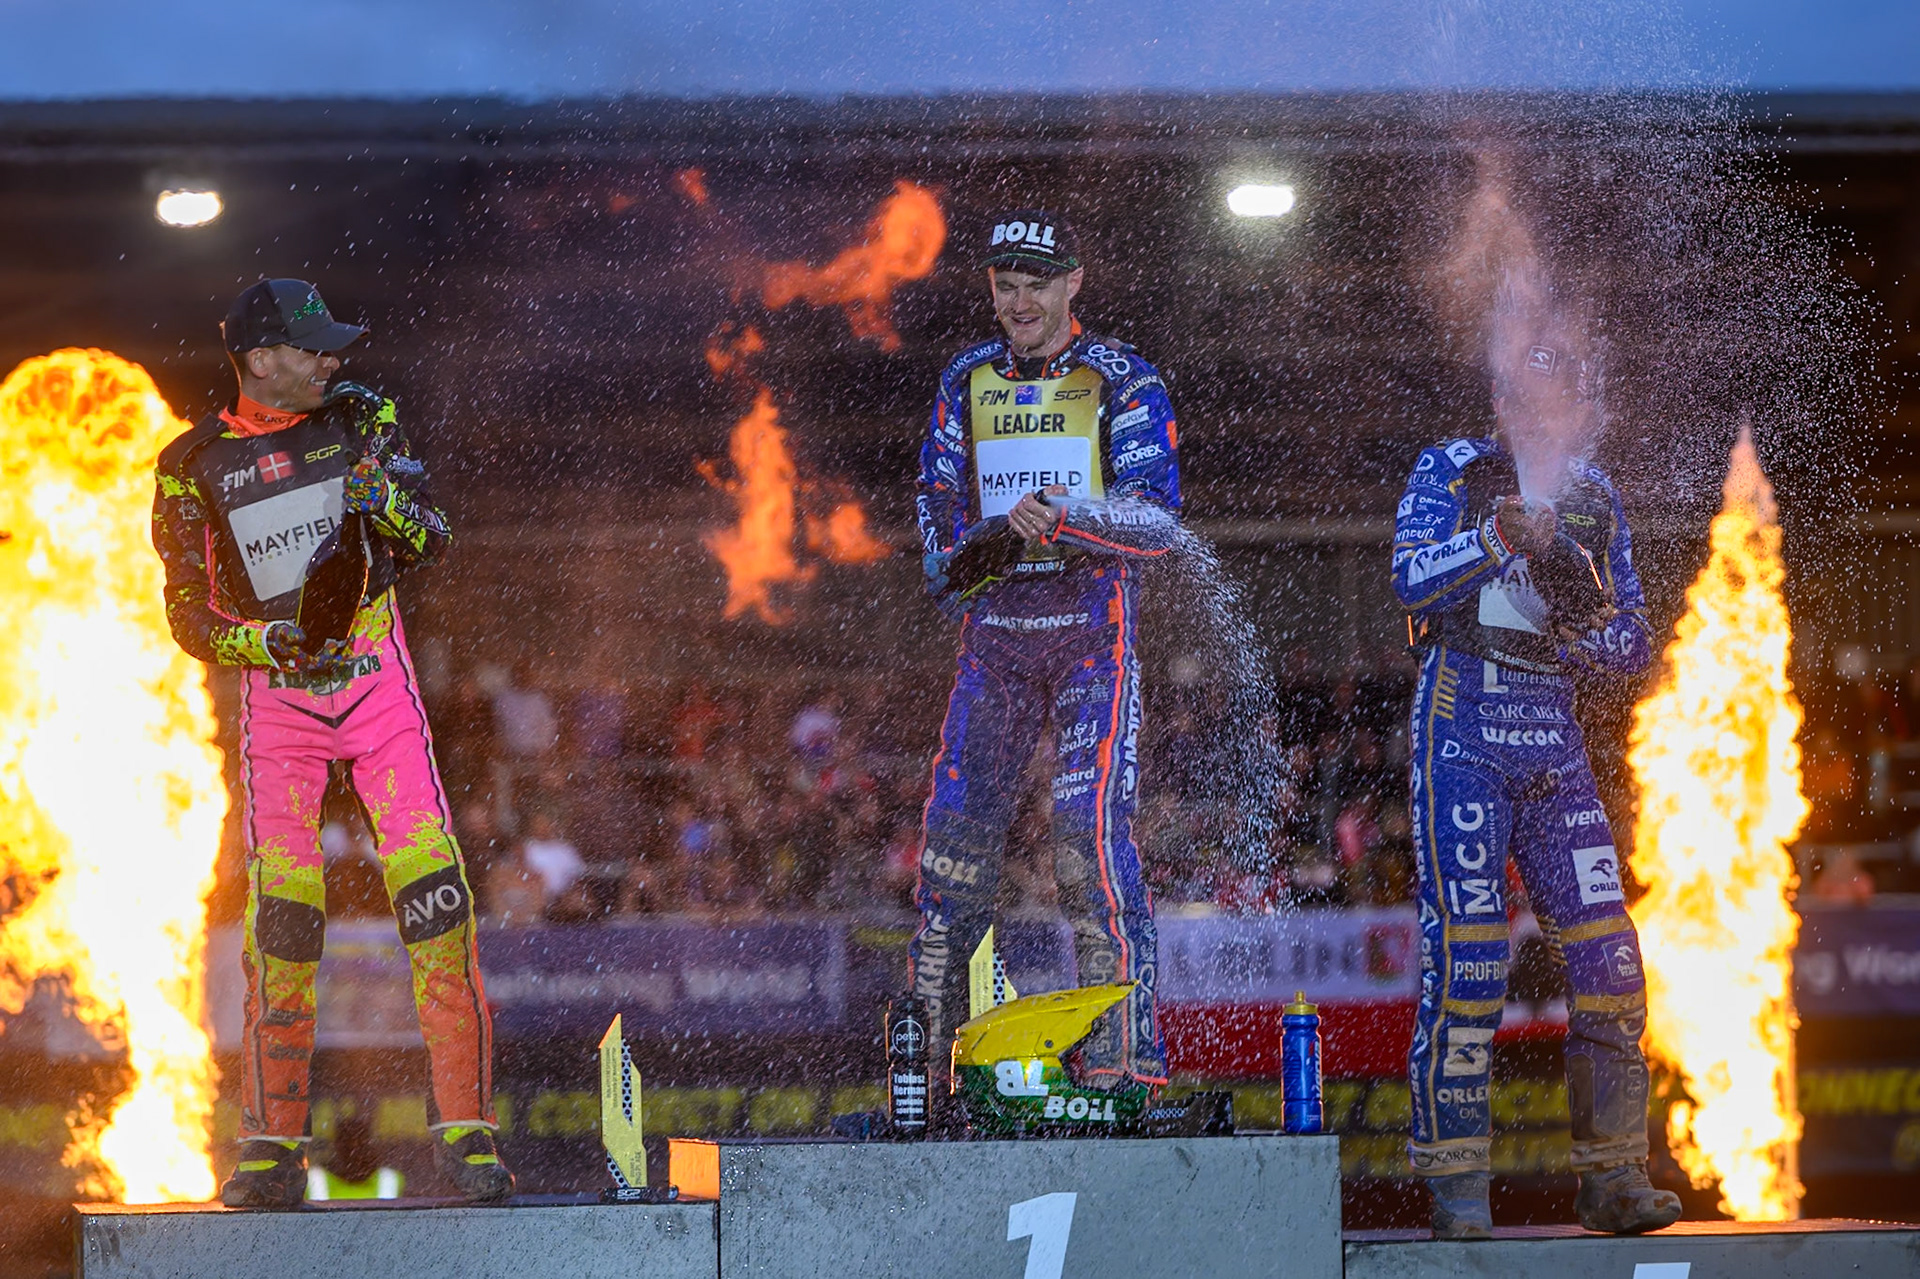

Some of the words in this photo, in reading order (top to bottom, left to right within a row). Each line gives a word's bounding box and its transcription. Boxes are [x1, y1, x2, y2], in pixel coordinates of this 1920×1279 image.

[991, 221, 1056, 246] BOLL
[977, 389, 1010, 406] FIM
[1054, 389, 1092, 401] SGP
[994, 413, 1066, 435] LEADER
[305, 444, 342, 464] SGP
[218, 465, 256, 492] FIM
[982, 470, 1083, 490] MAYFIELD
[1410, 675, 1428, 751] ORLEN
[1412, 804, 1428, 882] ORLEN
[895, 1031, 920, 1044] petit
[893, 1073, 926, 1084] Tobiasz
[893, 1086, 926, 1096] Herman
[1044, 1095, 1117, 1121] BOLL
[1006, 1192, 1078, 1279] 1
